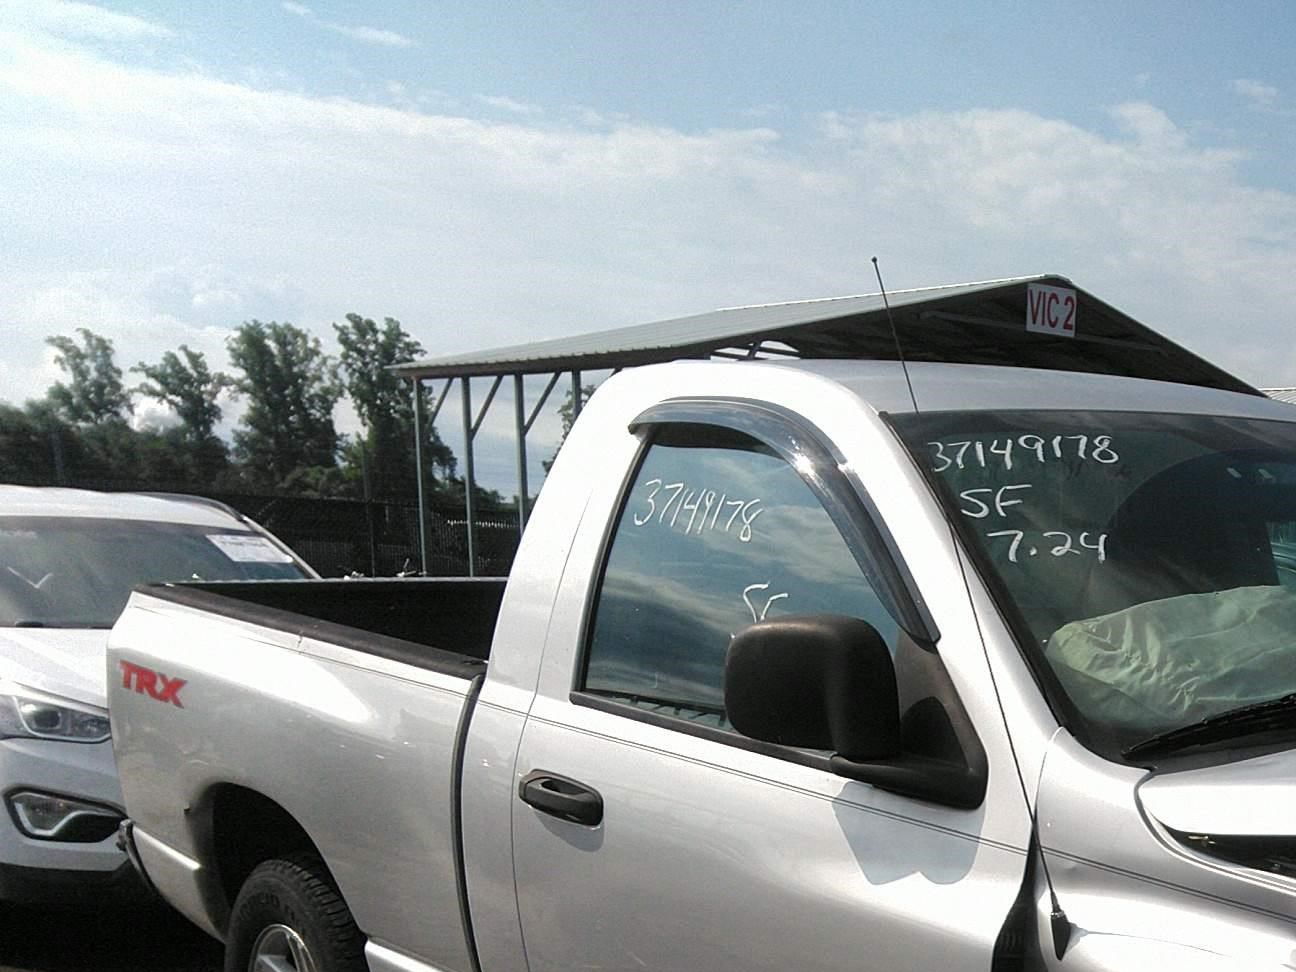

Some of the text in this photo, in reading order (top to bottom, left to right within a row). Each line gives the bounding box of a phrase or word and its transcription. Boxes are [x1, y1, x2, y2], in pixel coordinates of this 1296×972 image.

[1029, 287, 1075, 331] VIC 2
[927, 434, 1119, 472] 37149178
[633, 478, 764, 542] 37149178
[959, 483, 1033, 519] SF
[985, 529, 1108, 564] 7.24
[119, 658, 189, 710] TRX
